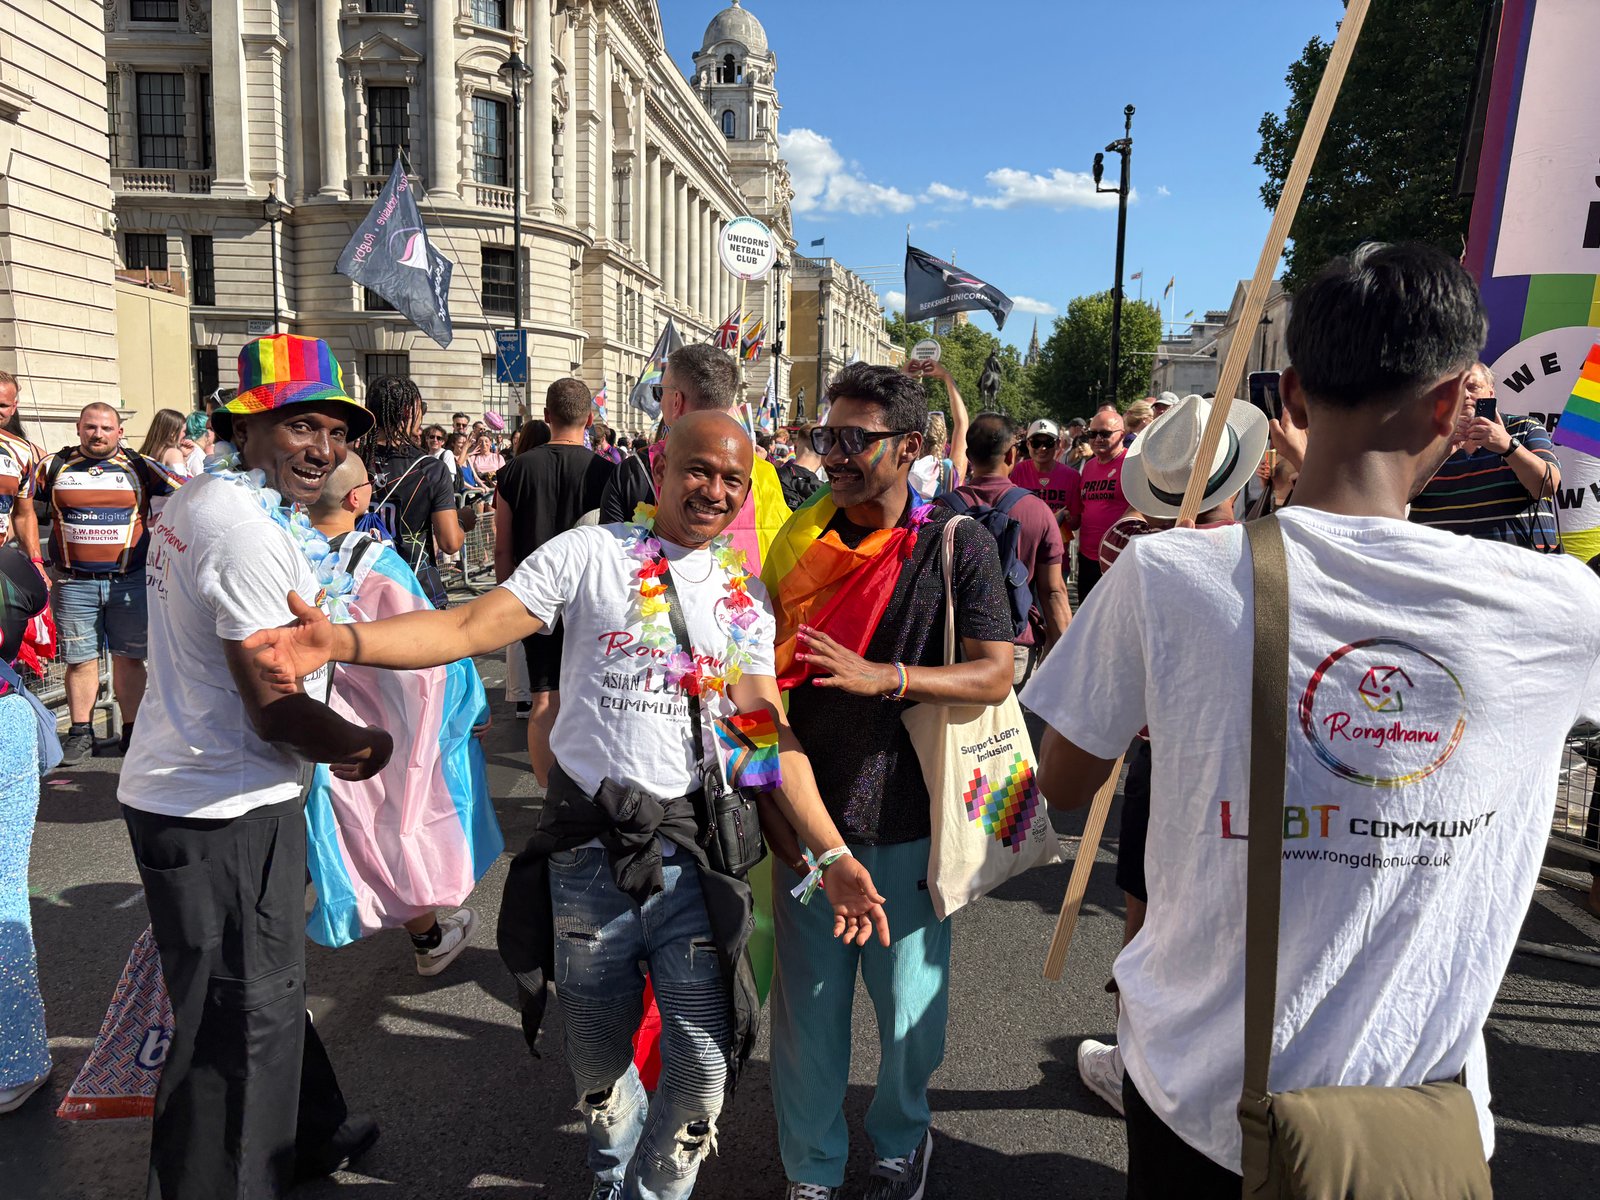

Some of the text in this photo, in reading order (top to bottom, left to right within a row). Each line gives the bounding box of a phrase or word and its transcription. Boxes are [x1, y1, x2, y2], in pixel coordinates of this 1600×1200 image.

[727, 233, 770, 248] UNICORNS
[730, 243, 766, 257] NETBALL
[736, 254, 758, 265] CLUB
[919, 296, 950, 311] BERKSHIRE
[951, 292, 991, 302] UNICORN
[1502, 352, 1561, 393] WE
[602, 672, 640, 691] ASIAN
[600, 695, 690, 717] COMMUNI
[961, 727, 1020, 755] Support LGBT+
[977, 743, 1013, 762] Inclusion
[1219, 800, 1340, 840] LBT
